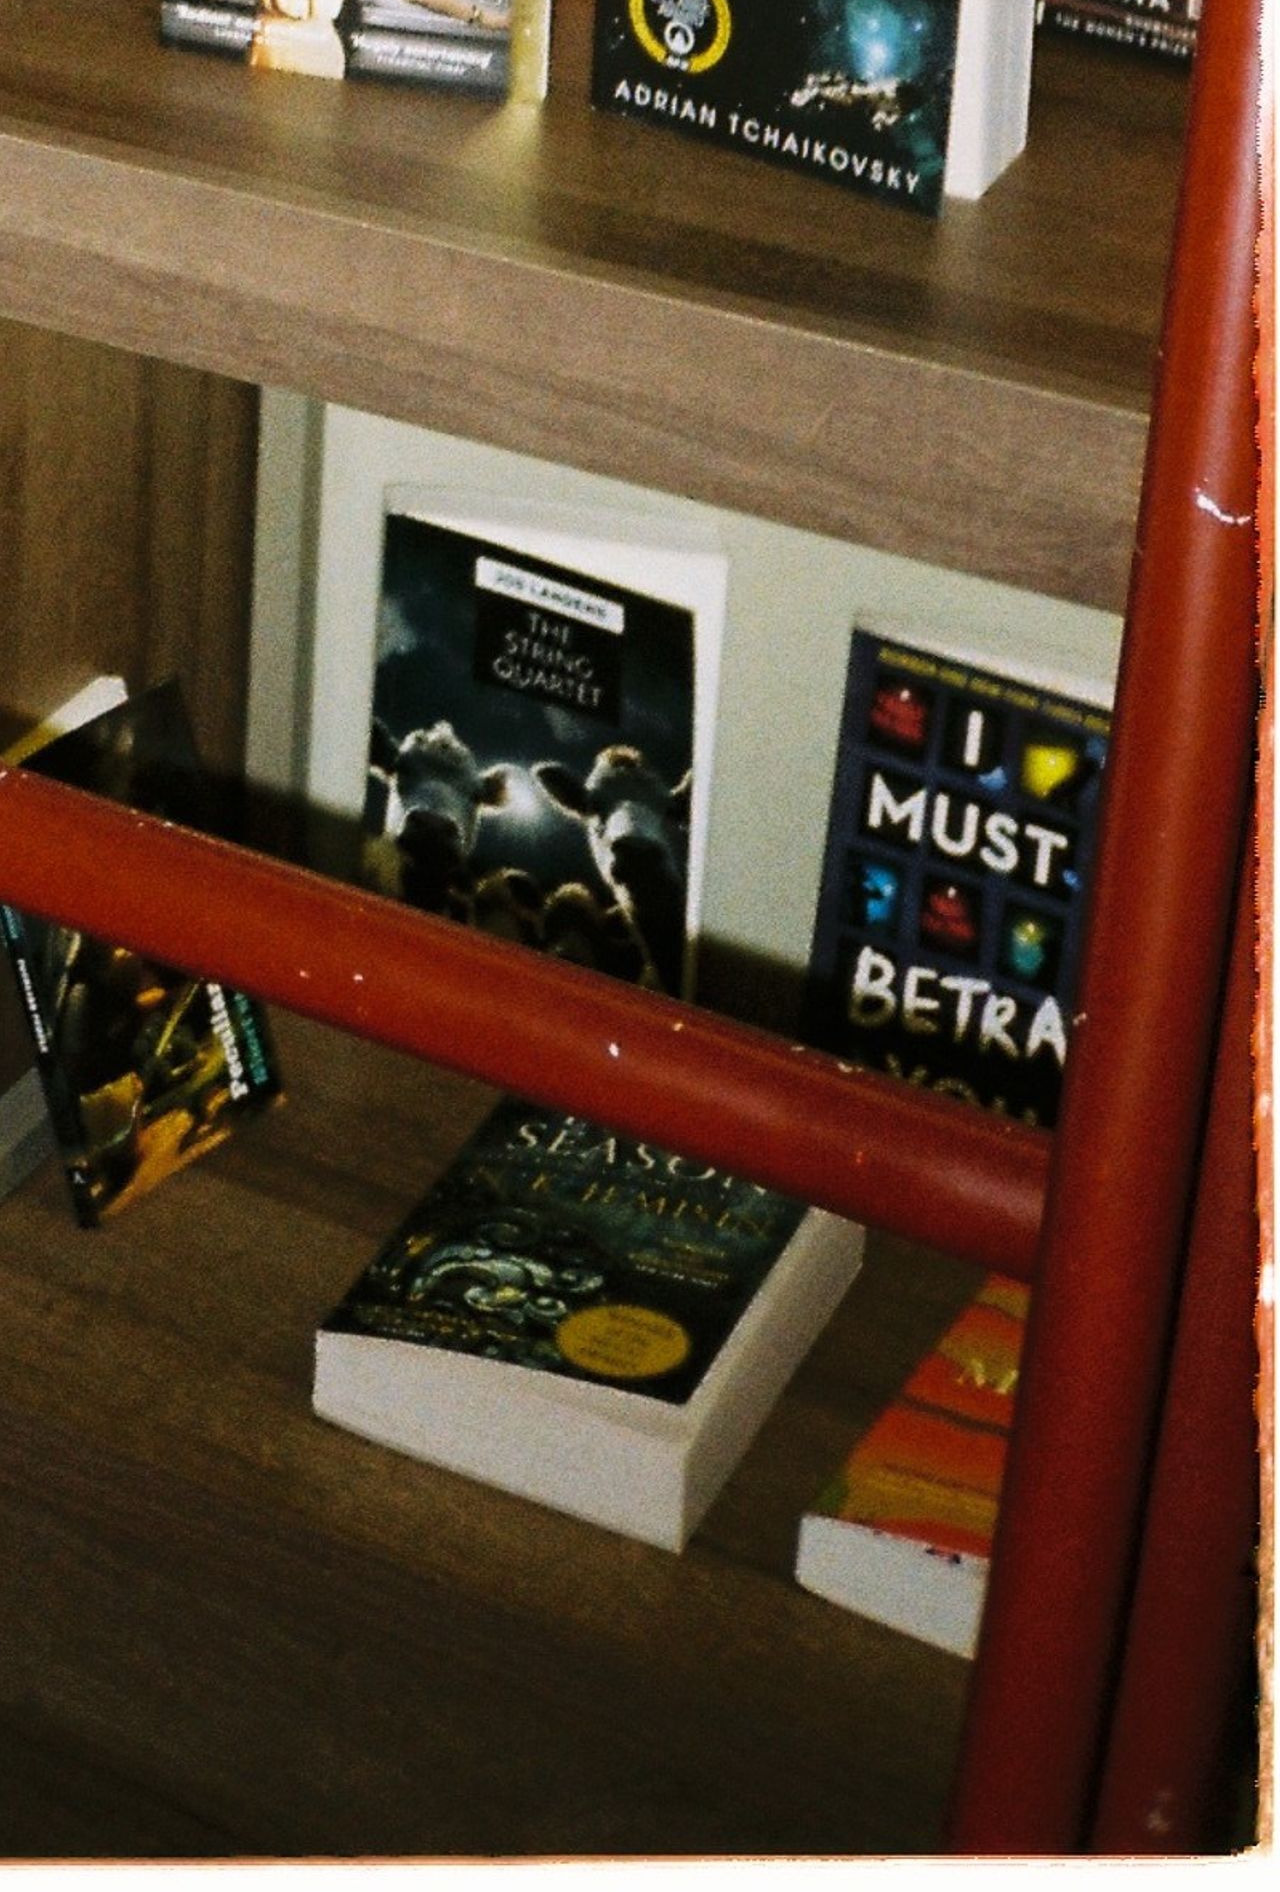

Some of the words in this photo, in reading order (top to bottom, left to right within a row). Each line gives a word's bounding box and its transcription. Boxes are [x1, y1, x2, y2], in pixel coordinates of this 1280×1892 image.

[614, 76, 717, 130] ADRIAN
[727, 112, 923, 196] TCHAIKOVSKY
[503, 629, 593, 680] STRING
[529, 613, 570, 645] THE
[492, 656, 603, 707] QUARTET
[962, 709, 984, 768] I
[867, 772, 1069, 886] MUST
[847, 944, 1067, 1068] BETRA
